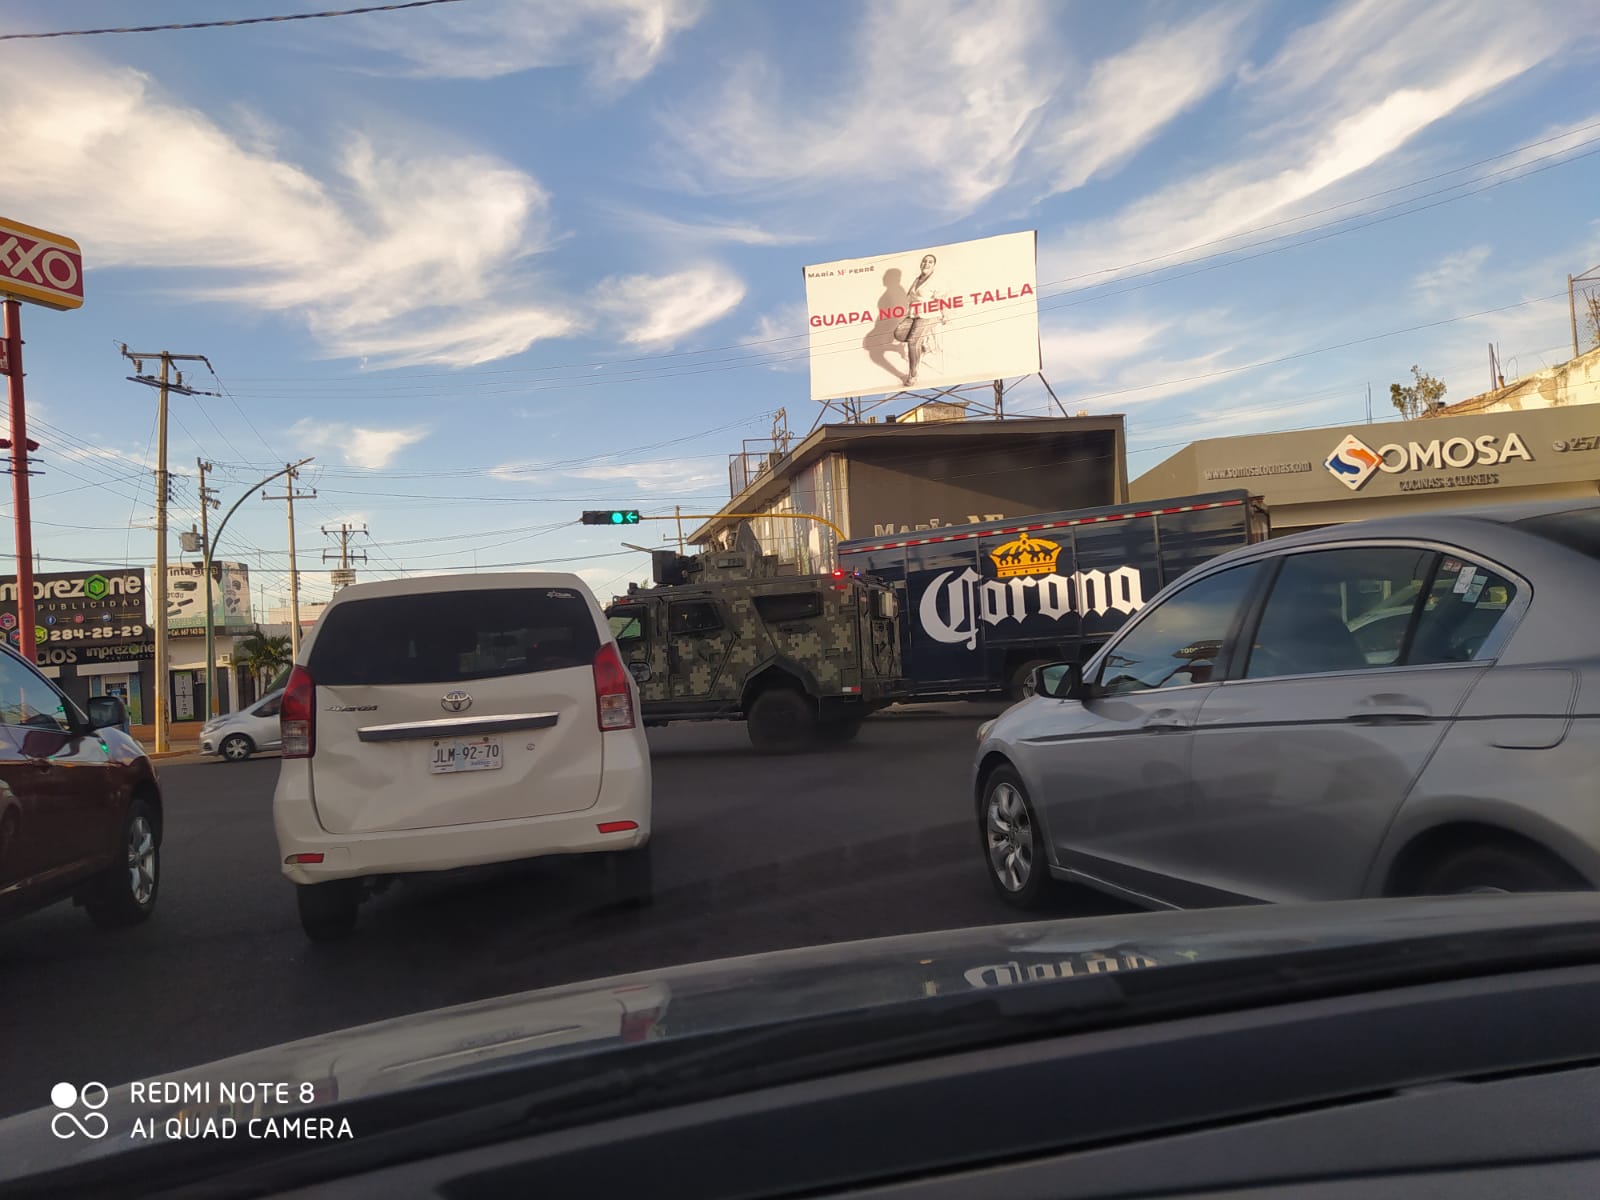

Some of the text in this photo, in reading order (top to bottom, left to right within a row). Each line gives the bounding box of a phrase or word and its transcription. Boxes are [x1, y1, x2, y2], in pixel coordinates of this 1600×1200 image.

[810, 283, 1034, 327] GUAPA NO TIENE TALLA
[38, 599, 140, 611] PUBLICIDAD
[919, 566, 1148, 651] Corona
[50, 625, 143, 641] 284-25-29
